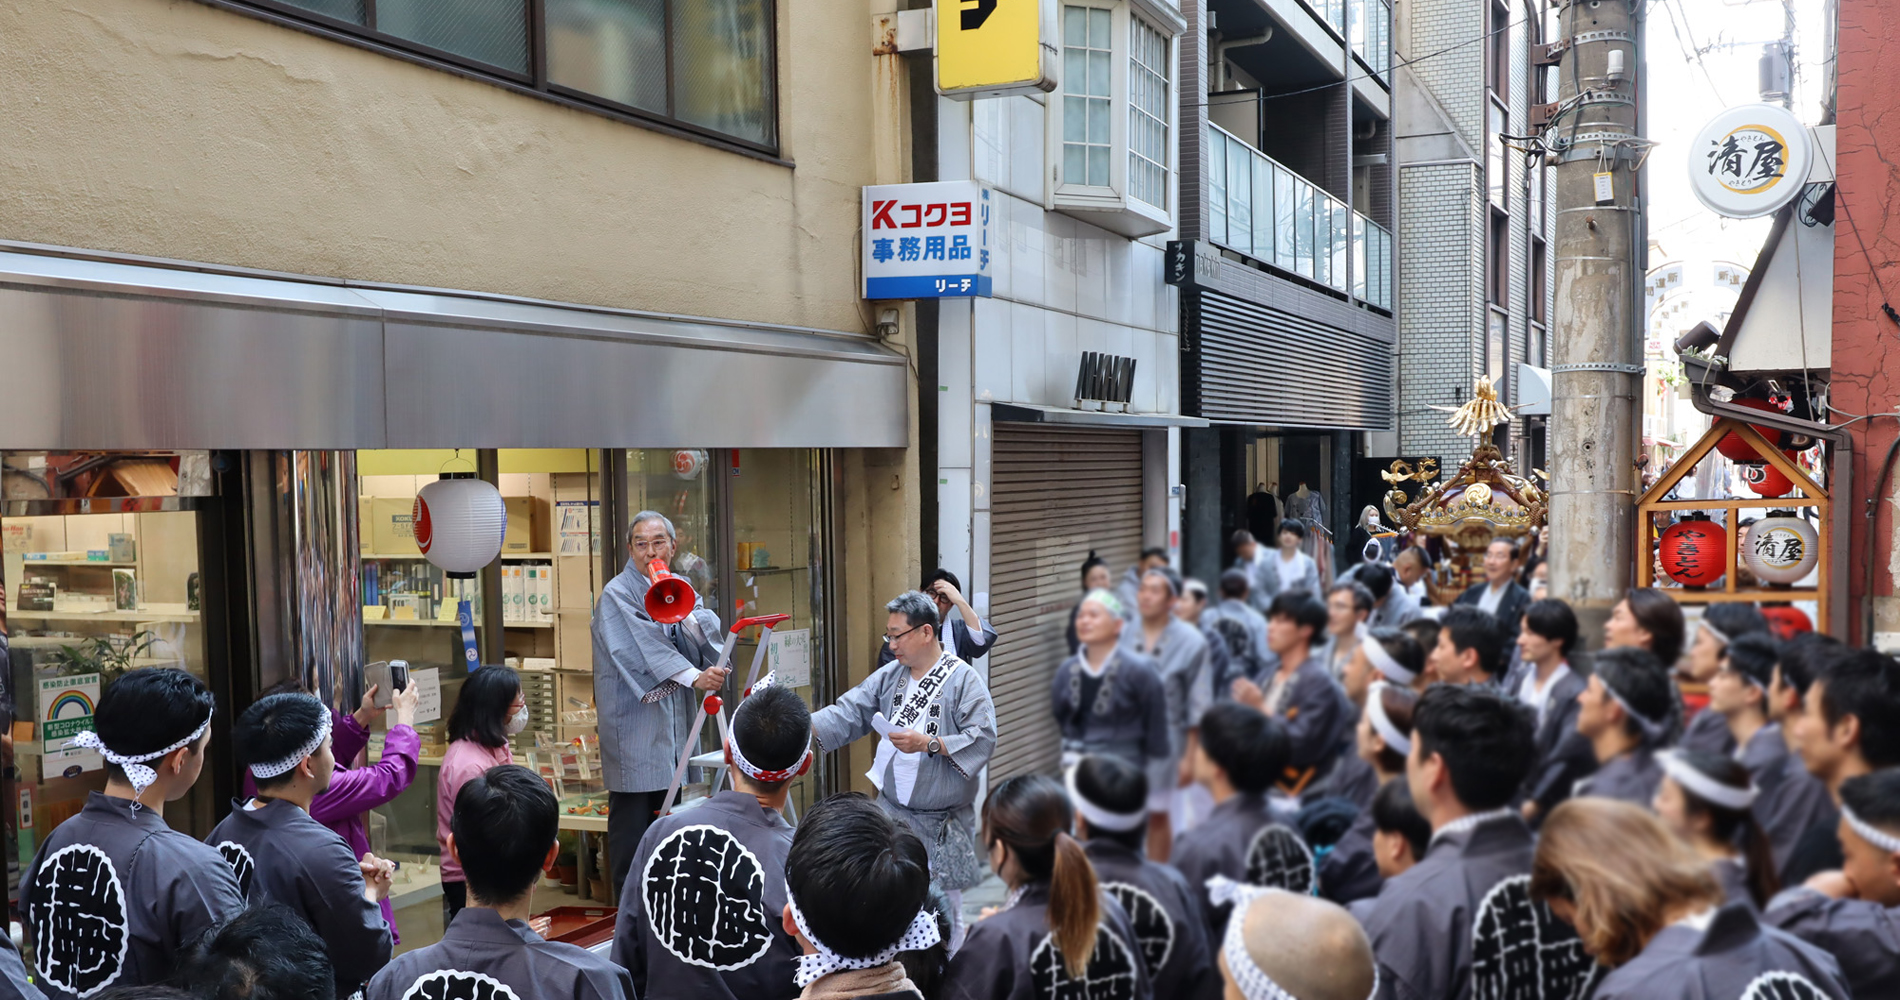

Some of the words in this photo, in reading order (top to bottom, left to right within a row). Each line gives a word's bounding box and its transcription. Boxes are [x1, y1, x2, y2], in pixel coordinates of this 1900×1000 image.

[1707, 135, 1784, 181] 清屋
[872, 235, 971, 263] 事務用品
[1174, 242, 1186, 282] ナカキン
[935, 279, 971, 292] リーチ
[1672, 529, 1706, 578] やきとん
[1755, 532, 1803, 562] 清屋
[926, 703, 941, 735] 横山
